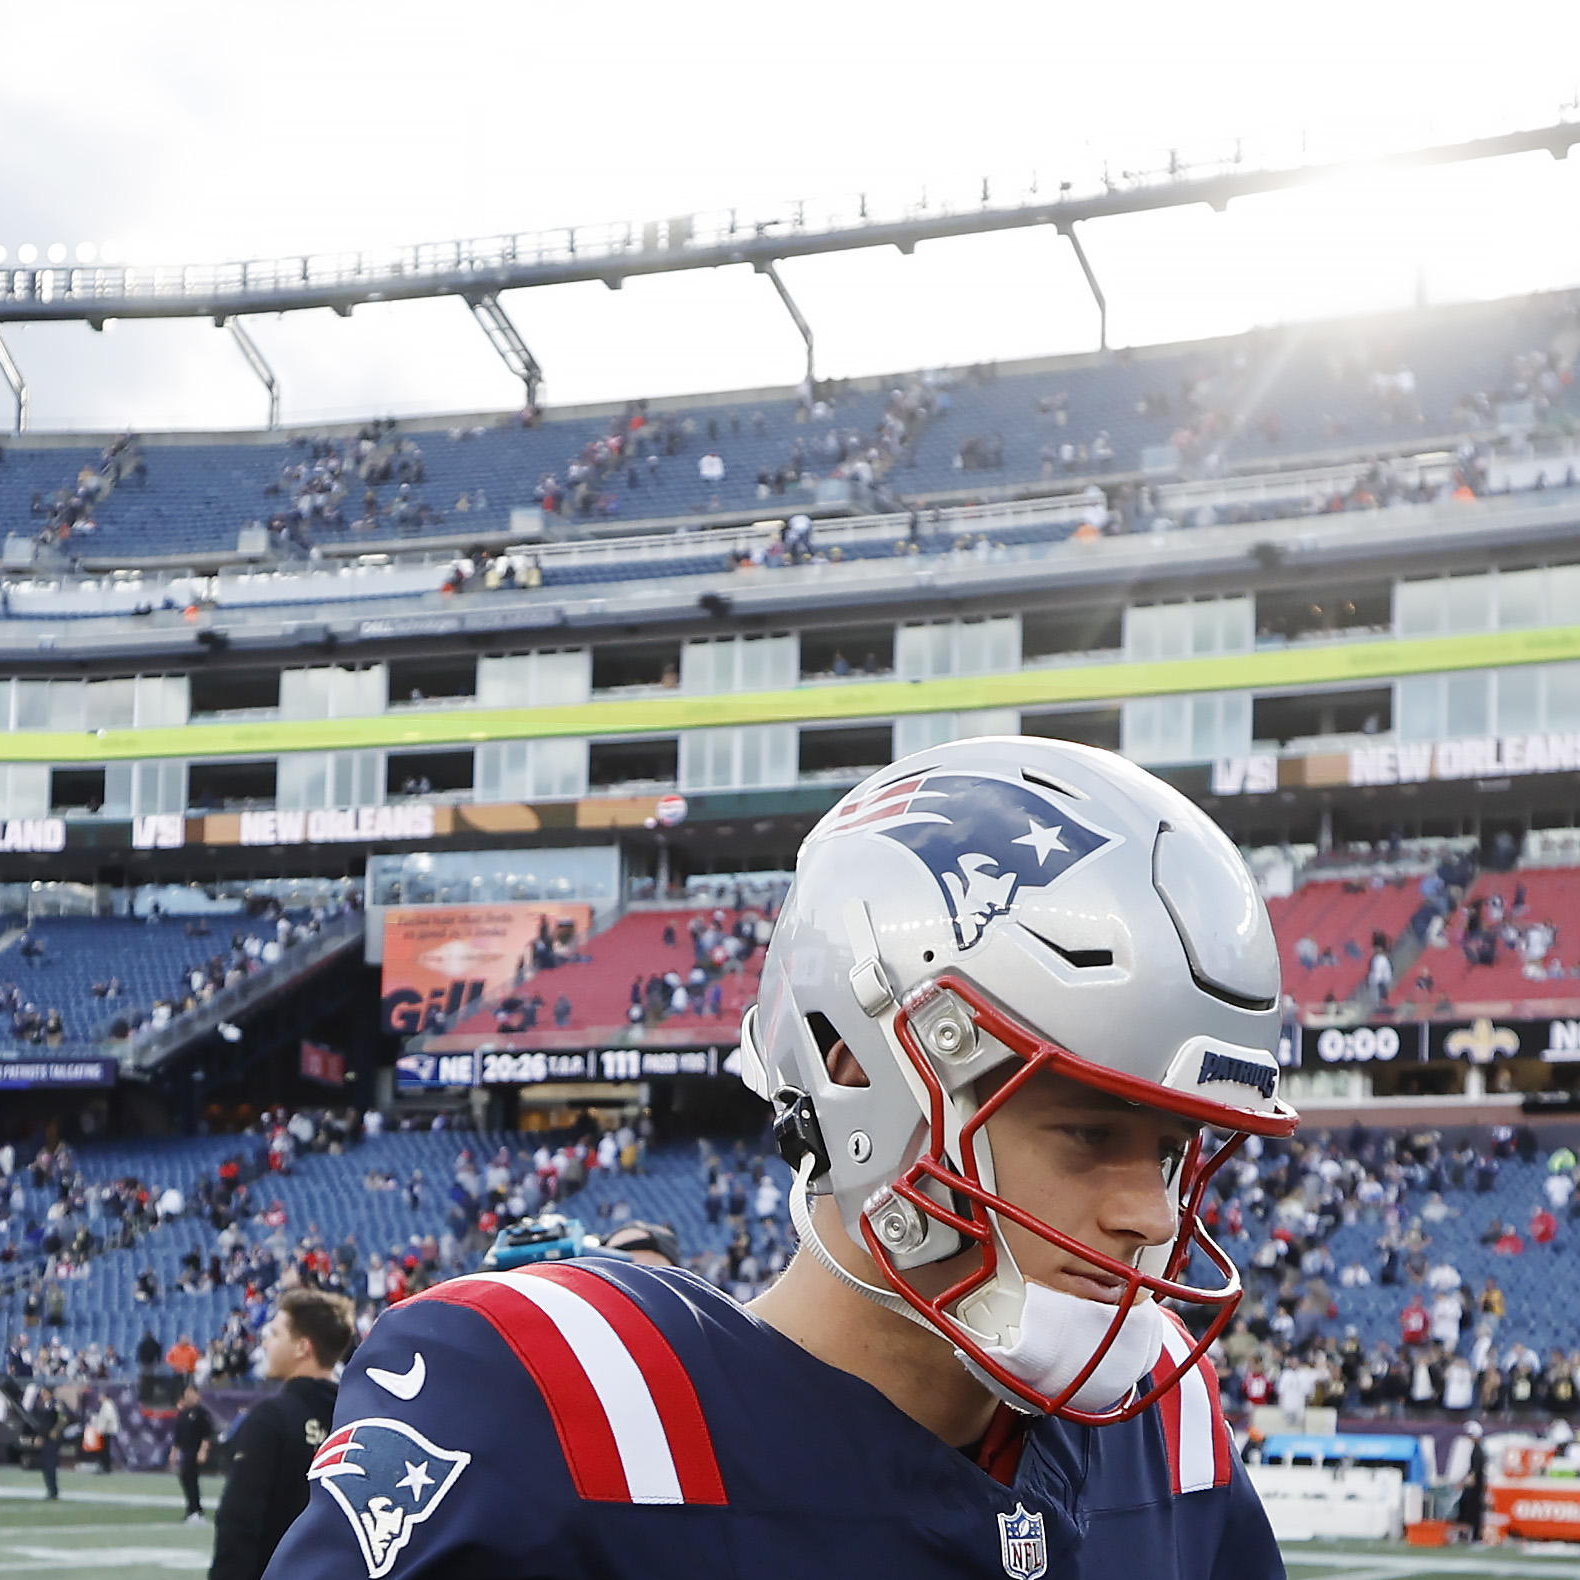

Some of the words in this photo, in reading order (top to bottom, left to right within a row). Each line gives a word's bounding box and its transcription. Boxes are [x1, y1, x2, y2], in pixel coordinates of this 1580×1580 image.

[1212, 756, 1278, 795] VS
[1348, 744, 1432, 787] NEW
[132, 815, 185, 849] VS
[240, 811, 304, 846] NEW
[308, 805, 435, 843] ORLEANS
[1317, 1027, 1400, 1063] 0:00
[439, 1056, 473, 1081] NE
[483, 1053, 547, 1082] 20:26
[602, 1050, 641, 1080] 111
[1011, 1541, 1042, 1572] NFL
